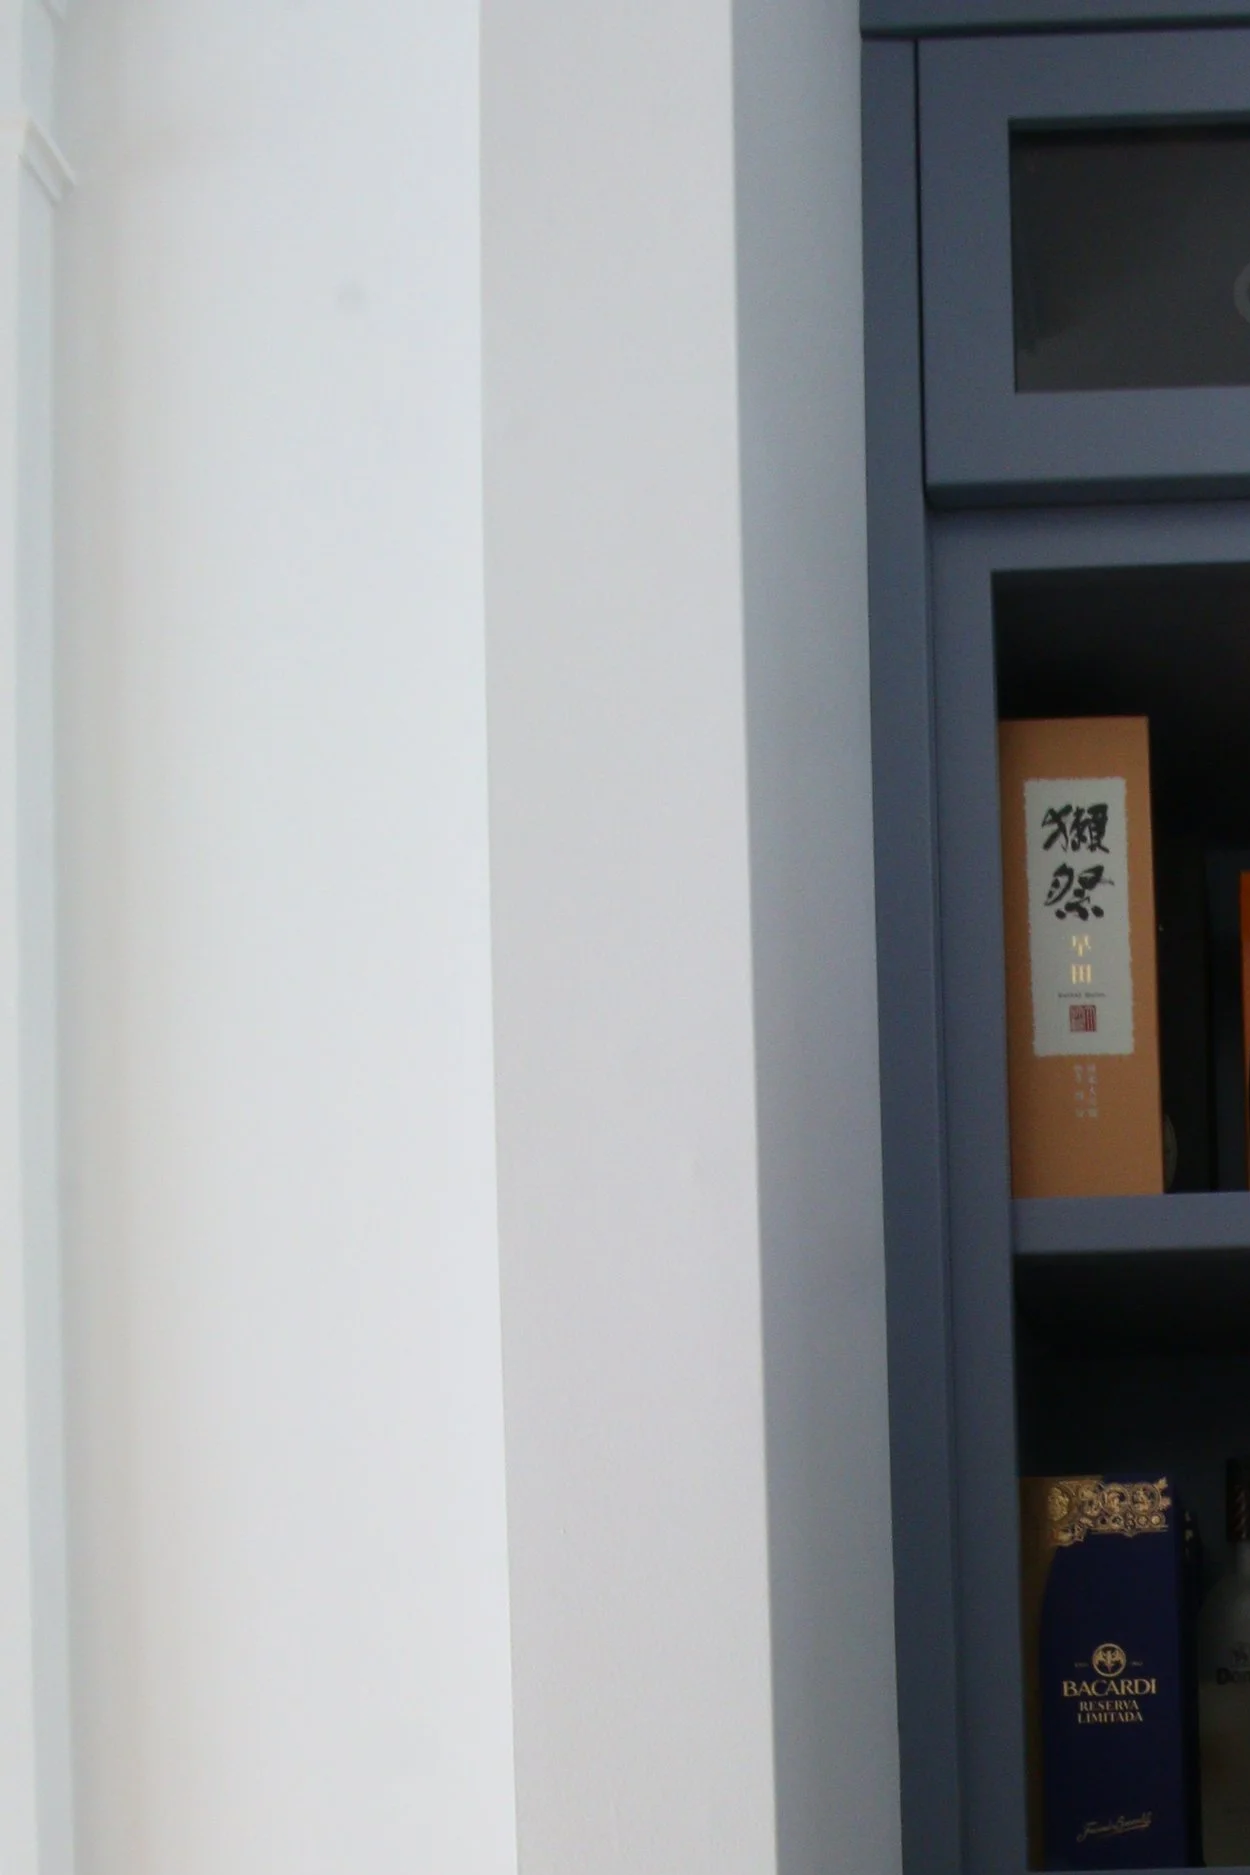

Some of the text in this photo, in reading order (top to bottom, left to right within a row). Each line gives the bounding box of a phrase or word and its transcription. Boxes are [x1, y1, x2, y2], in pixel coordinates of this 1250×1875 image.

[1062, 1678, 1157, 1697] BACARDI
[1079, 1699, 1139, 1712] RESERVA
[1077, 1711, 1144, 1725] LIMITADA
